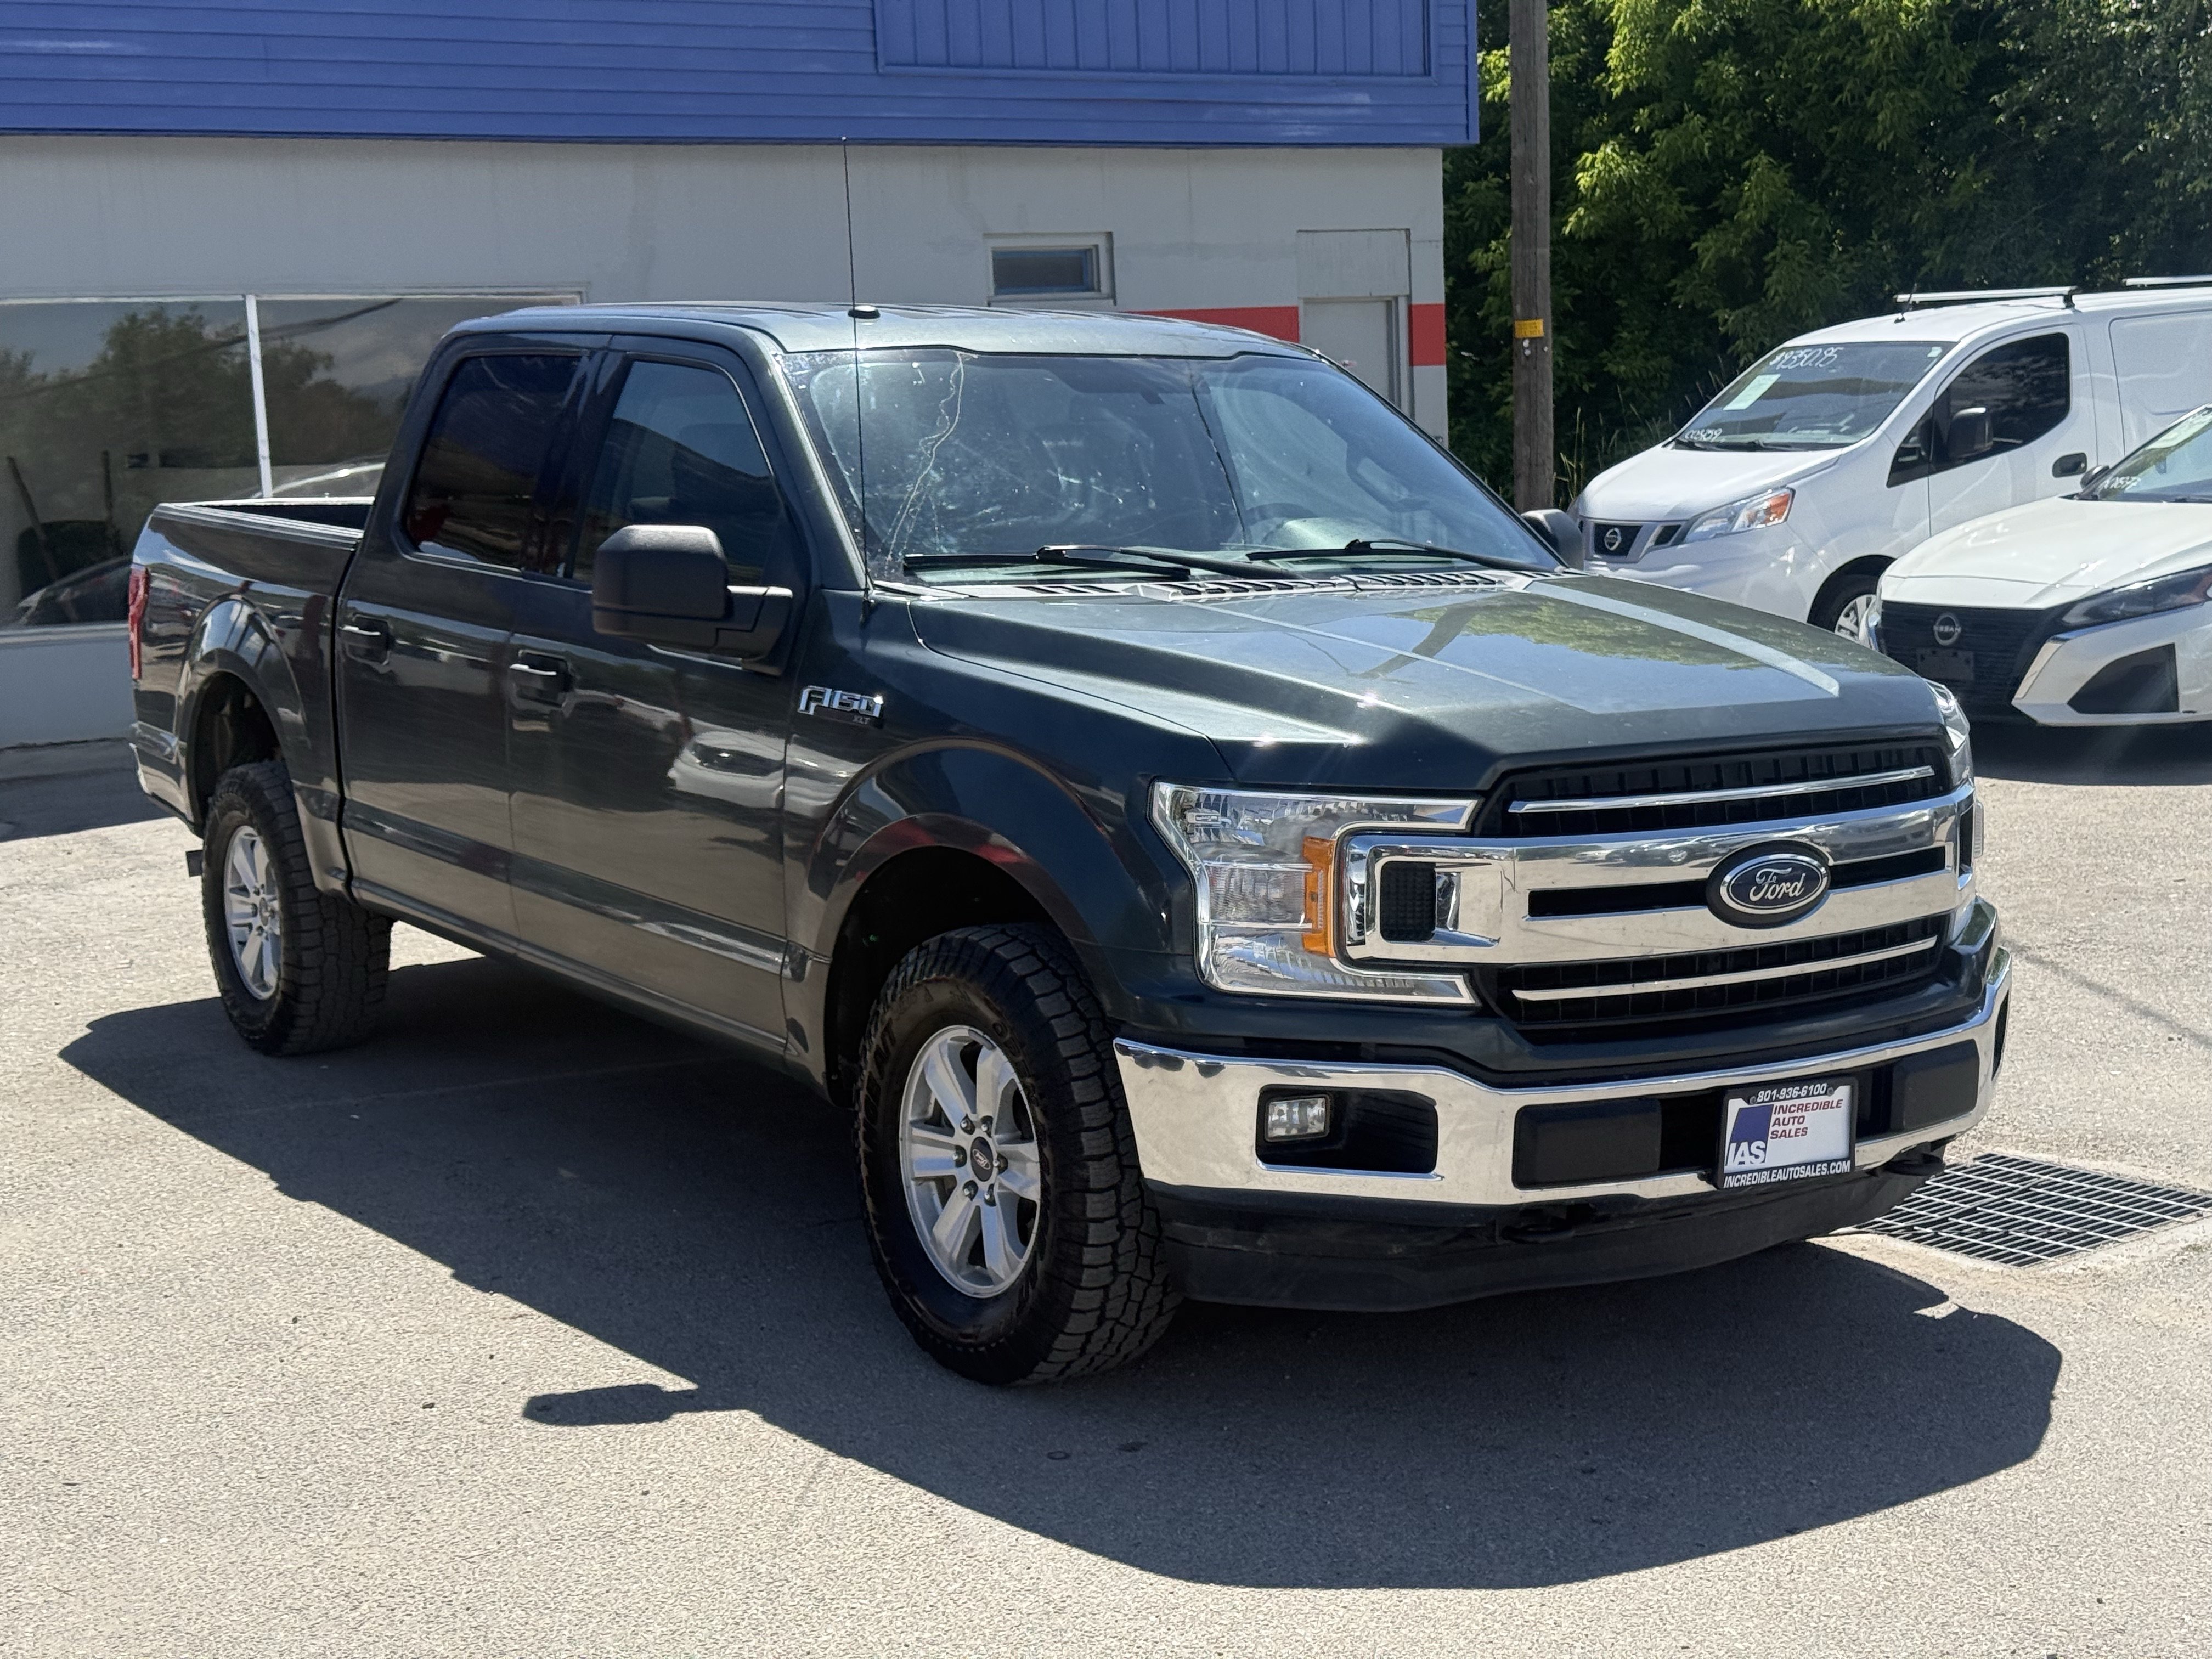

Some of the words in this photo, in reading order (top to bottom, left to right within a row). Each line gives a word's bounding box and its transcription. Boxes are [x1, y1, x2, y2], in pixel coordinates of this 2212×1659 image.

[1750, 867, 1807, 901] Ford
[1757, 1083, 1827, 1102] 801-936-6100
[1774, 1099, 1843, 1115] INCREDIBLE
[1772, 1115, 1805, 1127] AUTO
[1770, 1127, 1808, 1139] SALES
[1728, 1141, 1766, 1166] IAS
[1723, 1160, 1851, 1188] INCREDIBLEAUTOSALES.COM
